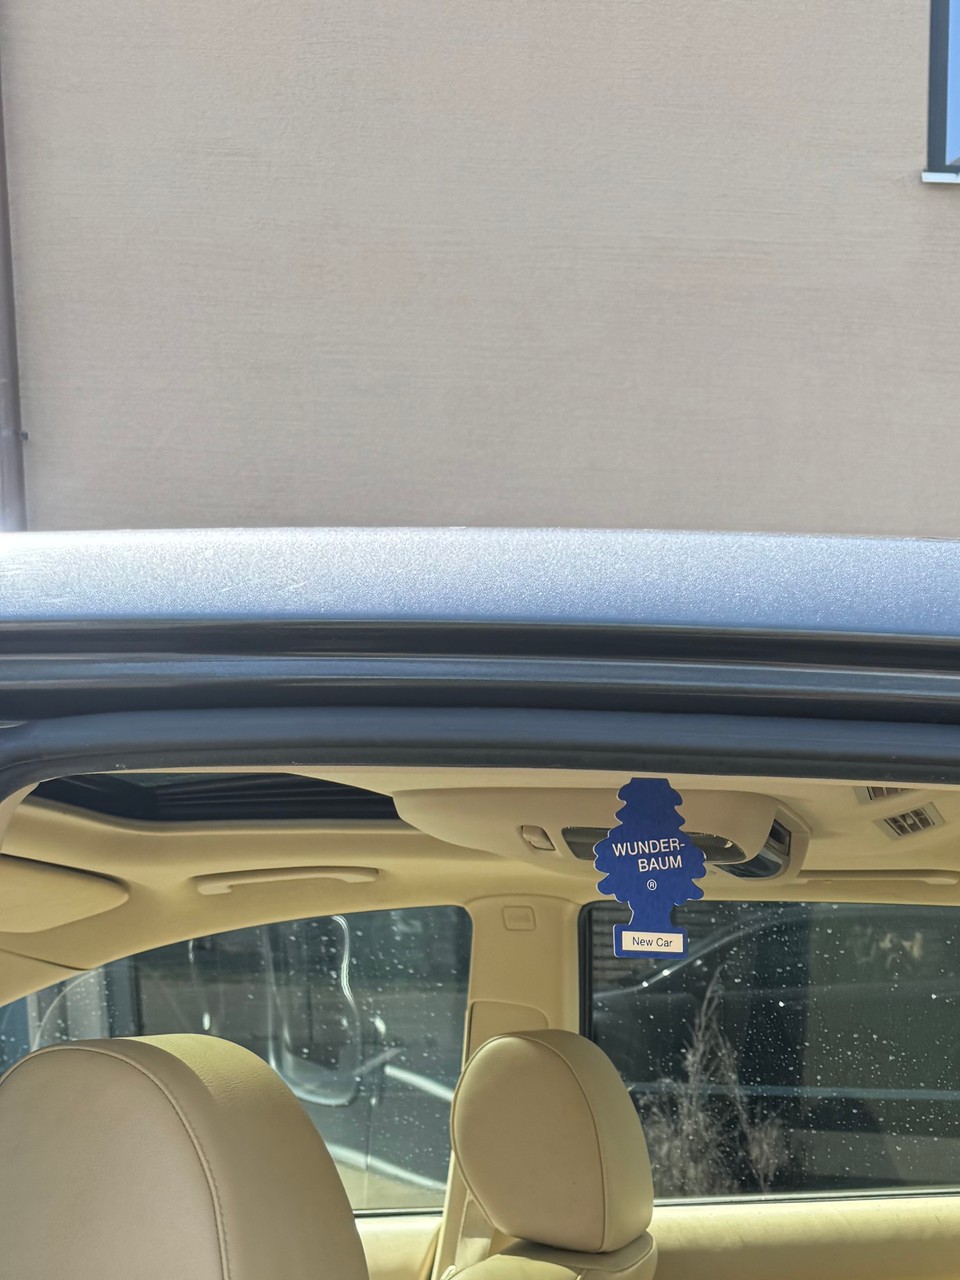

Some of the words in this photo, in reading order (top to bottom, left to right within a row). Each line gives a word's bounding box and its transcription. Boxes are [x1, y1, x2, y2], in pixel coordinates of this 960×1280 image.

[612, 838, 686, 857] WUNDER-
[638, 855, 683, 872] BAUM
[632, 936, 653, 946] New
[656, 937, 673, 947] Car
